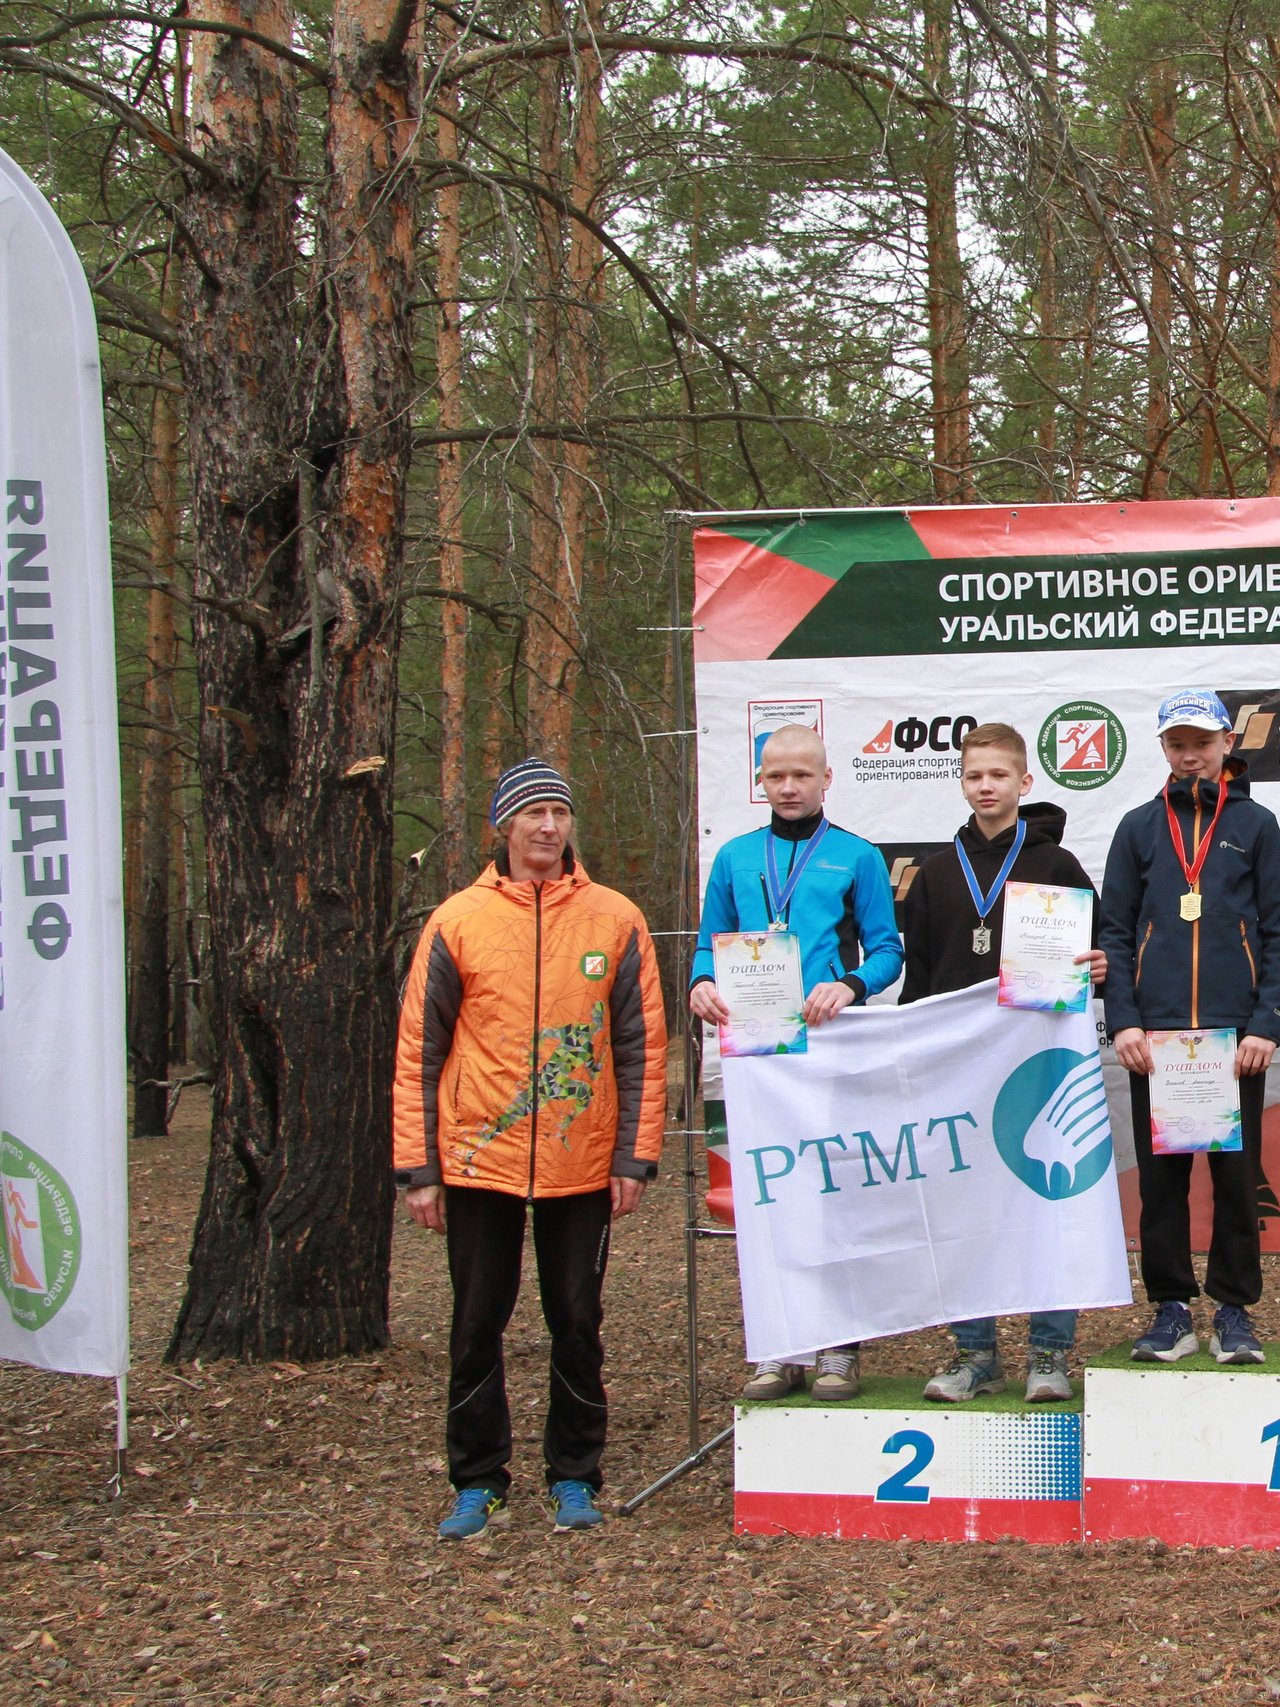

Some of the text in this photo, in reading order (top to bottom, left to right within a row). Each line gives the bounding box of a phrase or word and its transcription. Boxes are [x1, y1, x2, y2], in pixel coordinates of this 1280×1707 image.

[939, 567, 1179, 602] СПОРТИВНОЕ
[939, 604, 1140, 643] УРАЛЬСКИЙ
[894, 715, 978, 753] ФСО
[1041, 705, 1123, 787] ФЕДЕРАЦИЯ СПОРТИВНОГО ОРИЕНТИРОВАНИЯ ТЮМЕНСКОЙ ОБЛАСТИ
[852, 757, 962, 771] Федерация спортив
[856, 769, 949, 783] ориентирования
[1019, 915, 1077, 928] ДИПЛОМ
[728, 963, 786, 974] ДИПЛОМ
[1163, 1061, 1222, 1072] ДИПЛОМ
[875, 1429, 935, 1502] 2
